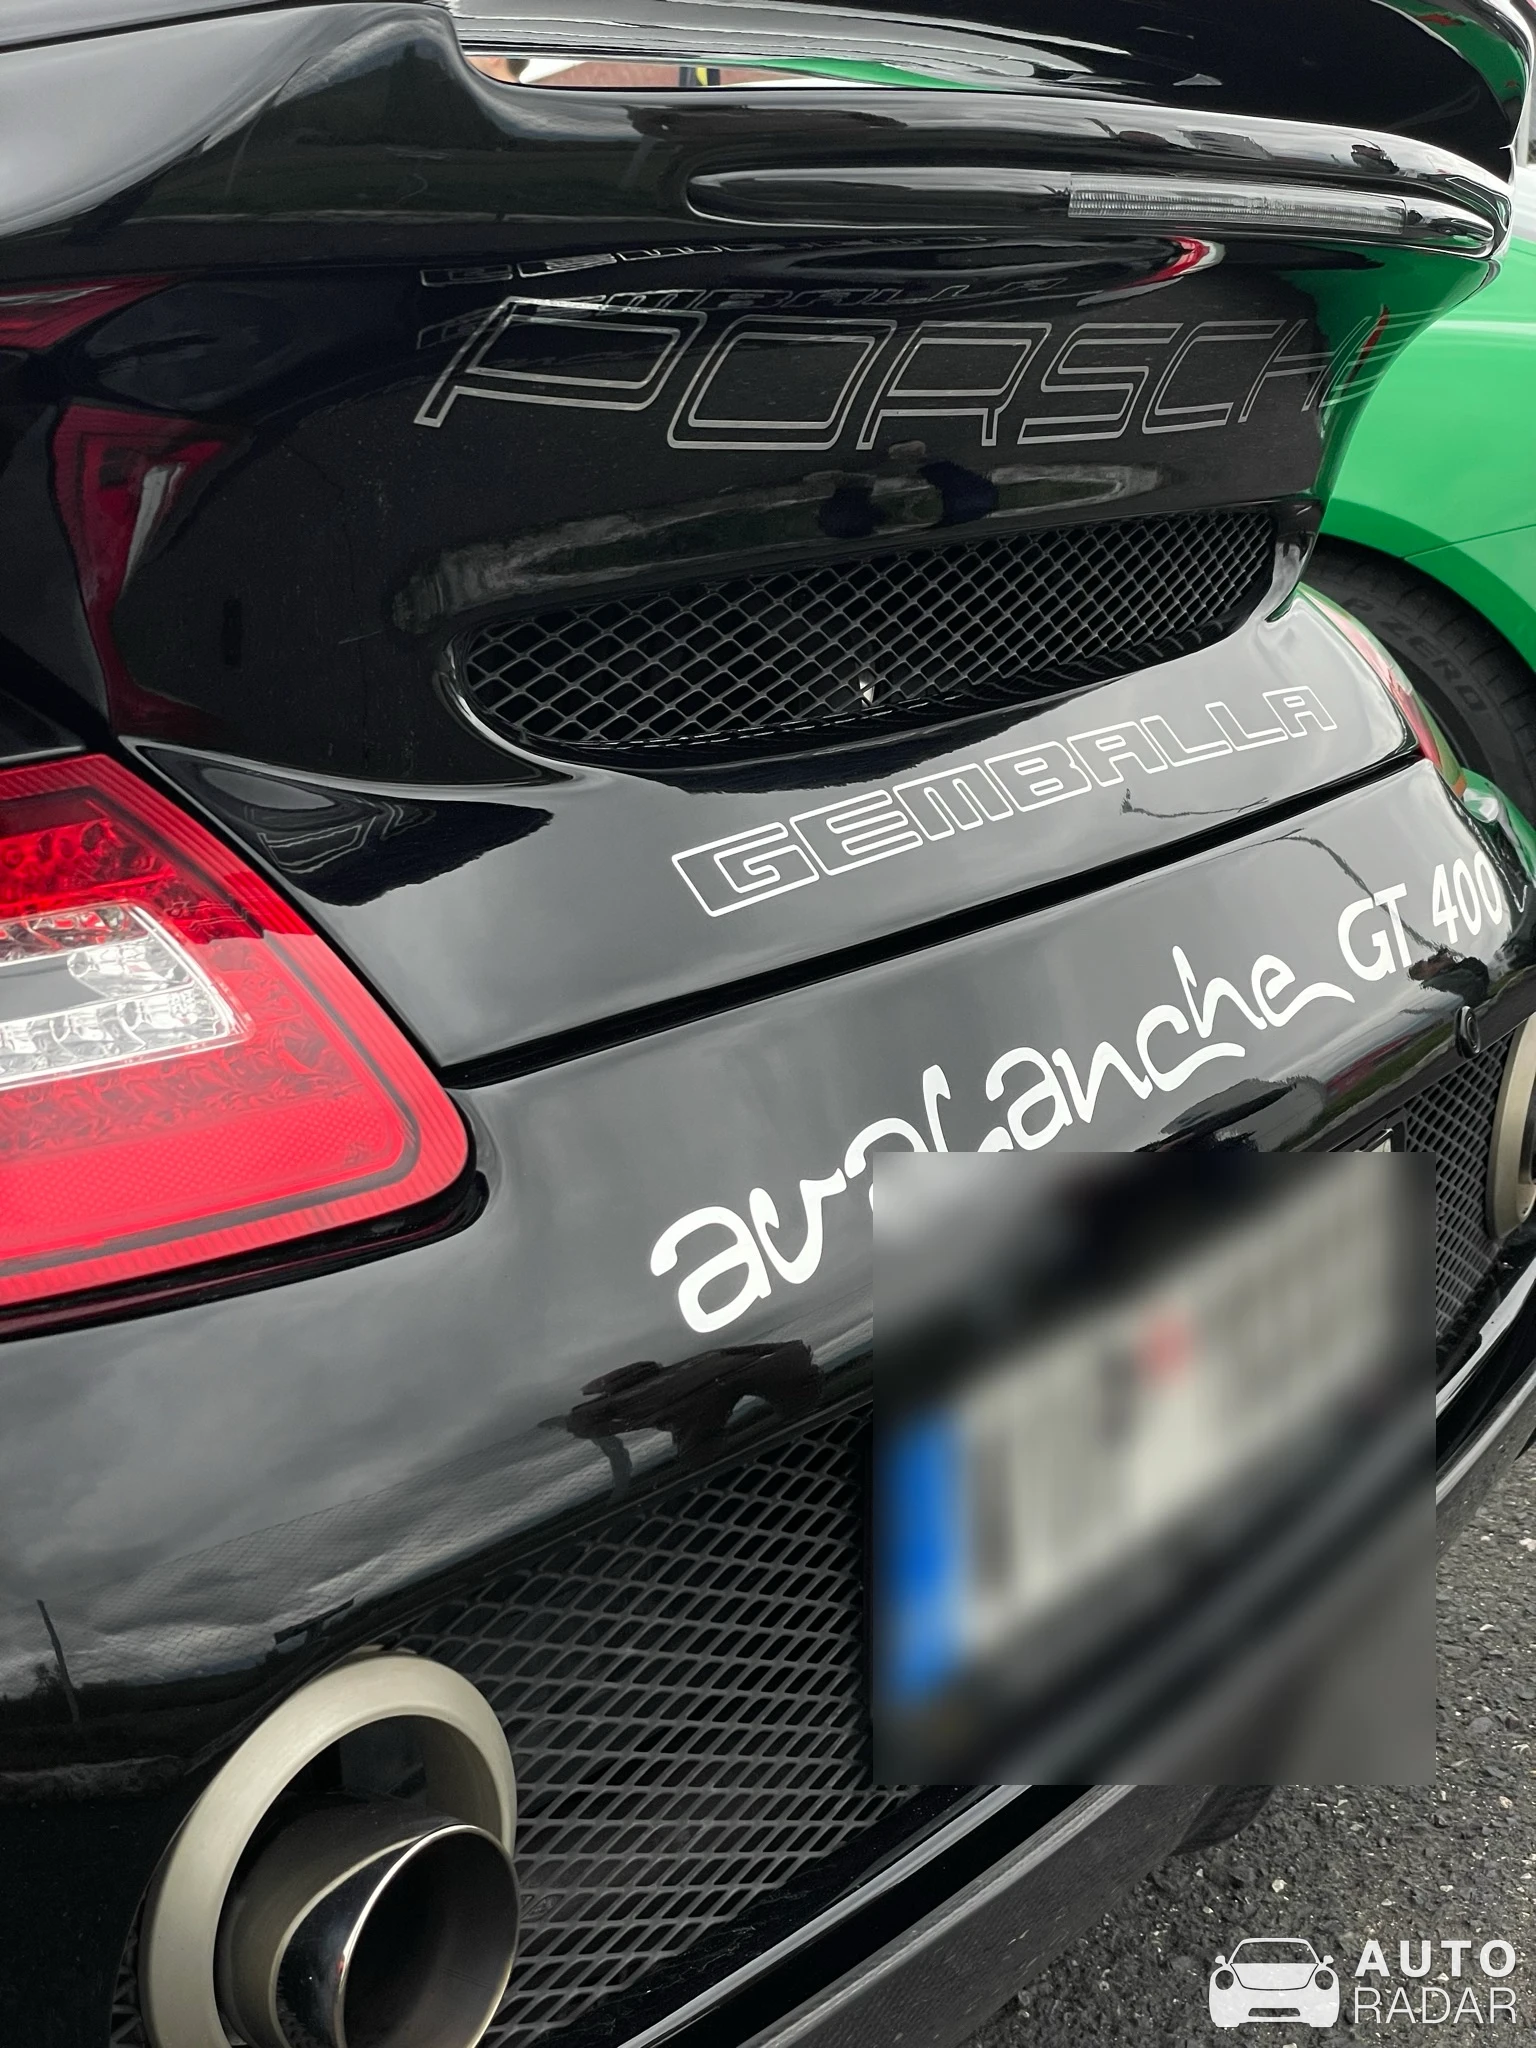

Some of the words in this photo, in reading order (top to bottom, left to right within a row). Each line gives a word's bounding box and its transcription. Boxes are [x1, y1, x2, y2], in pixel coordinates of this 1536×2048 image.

[413, 295, 1446, 451] PORSCHE
[1377, 614, 1488, 713] ZERO
[671, 685, 1338, 917] GEMBALLA
[1337, 882, 1413, 982] GT
[1431, 850, 1504, 945] 400
